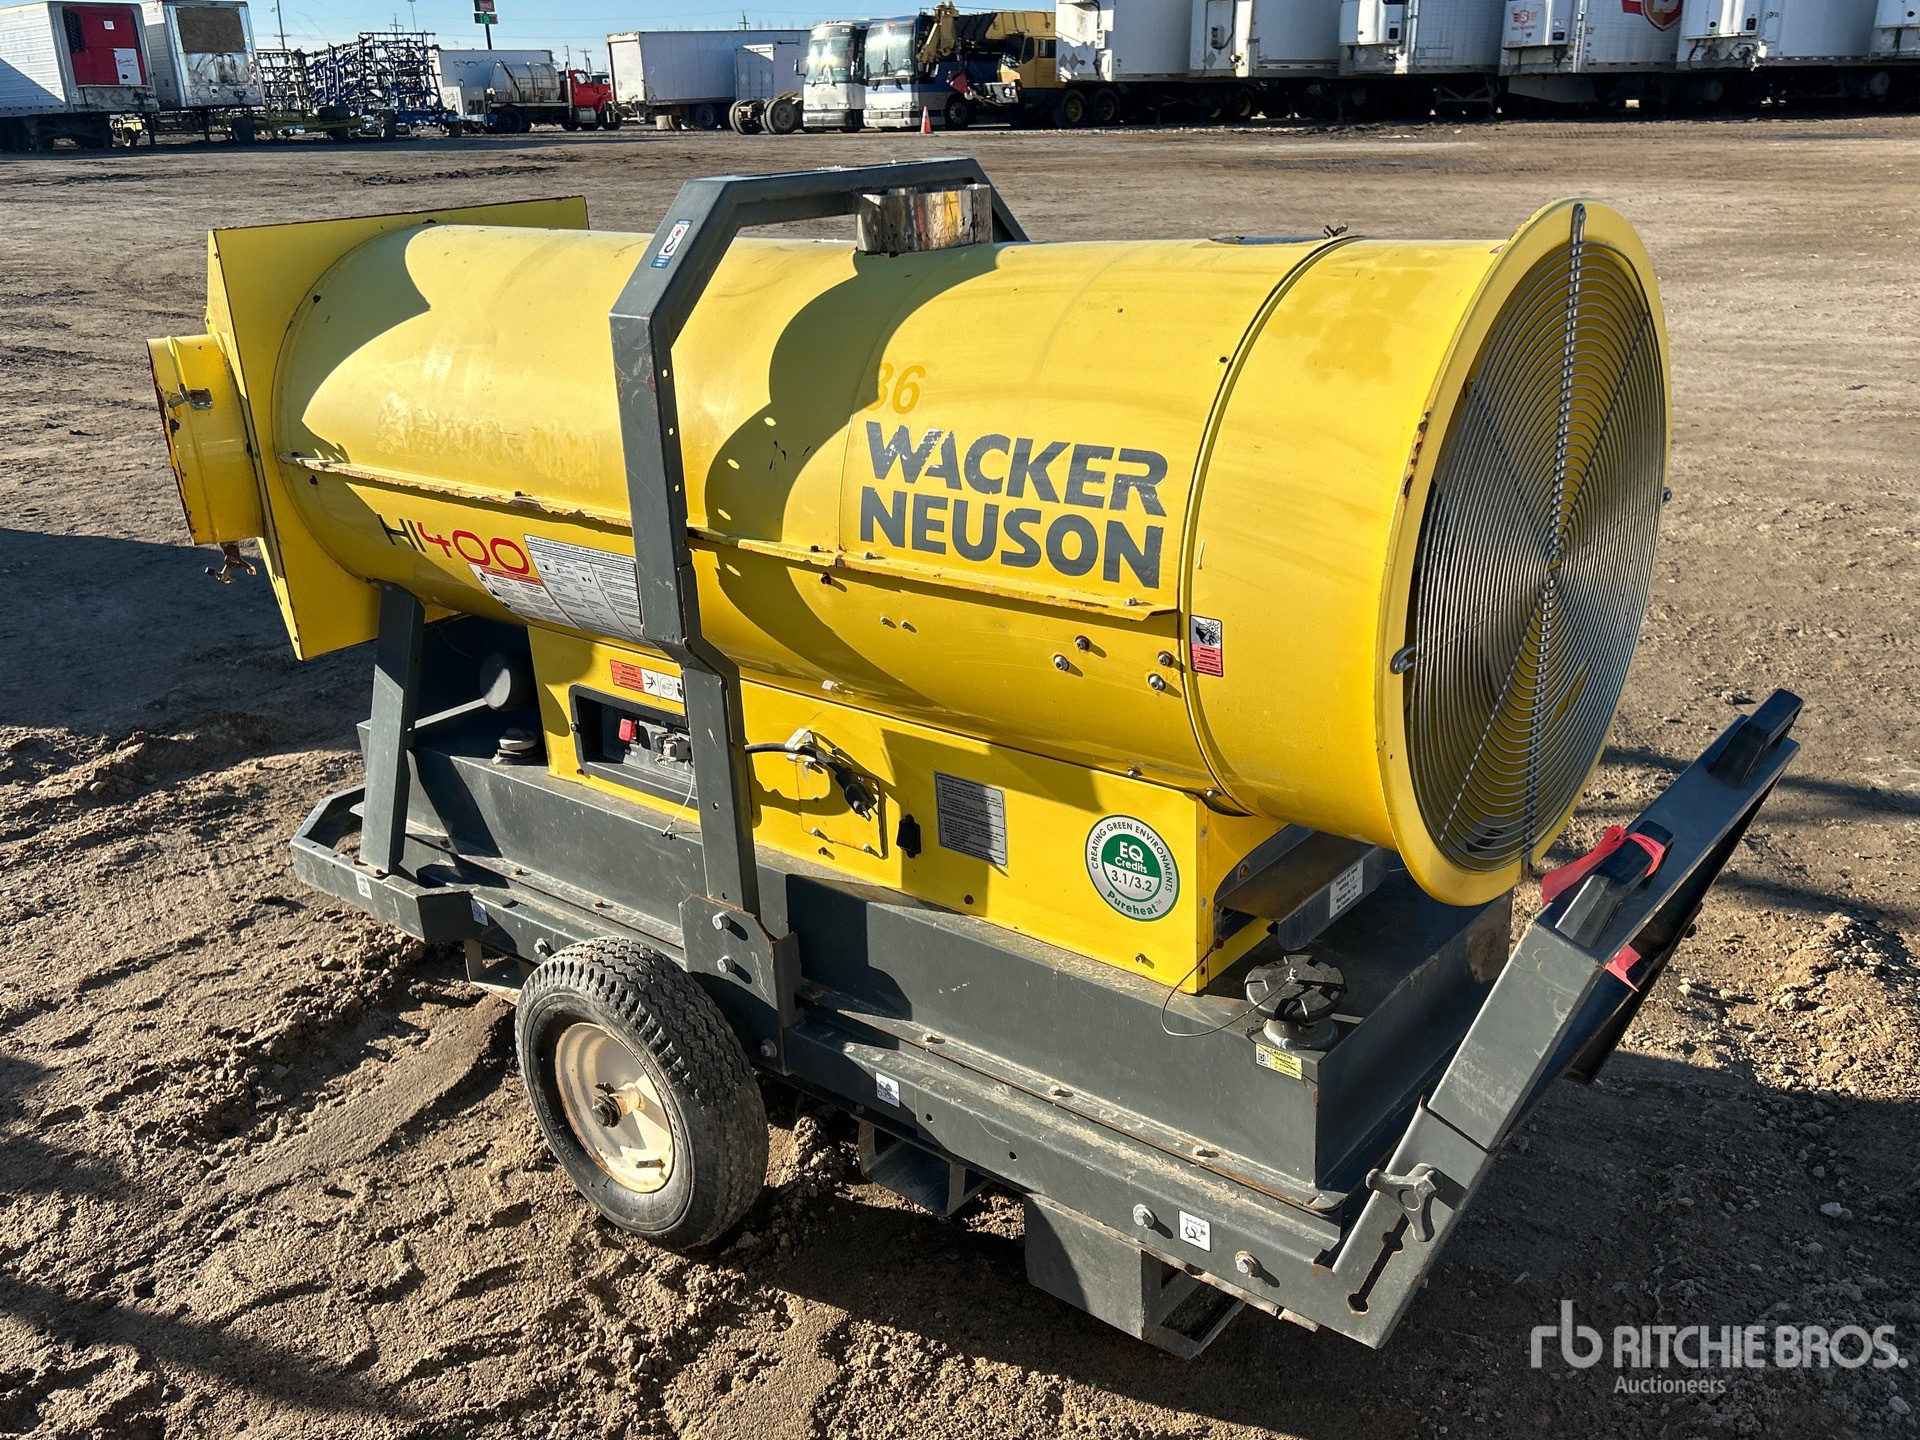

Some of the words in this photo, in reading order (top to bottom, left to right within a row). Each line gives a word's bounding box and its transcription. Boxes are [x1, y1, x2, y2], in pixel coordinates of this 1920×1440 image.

[865, 420, 1168, 518] WACKER
[376, 514, 530, 575] HI400
[859, 486, 1165, 590] NEUSON
[1090, 828, 1107, 870] CREATING
[1106, 821, 1133, 832] GREEN
[1135, 825, 1173, 893] ENVIRONMENTS
[1111, 869, 1153, 893] 3.1/3.2
[1114, 856, 1148, 874] Credits
[1119, 841, 1144, 863] EQ
